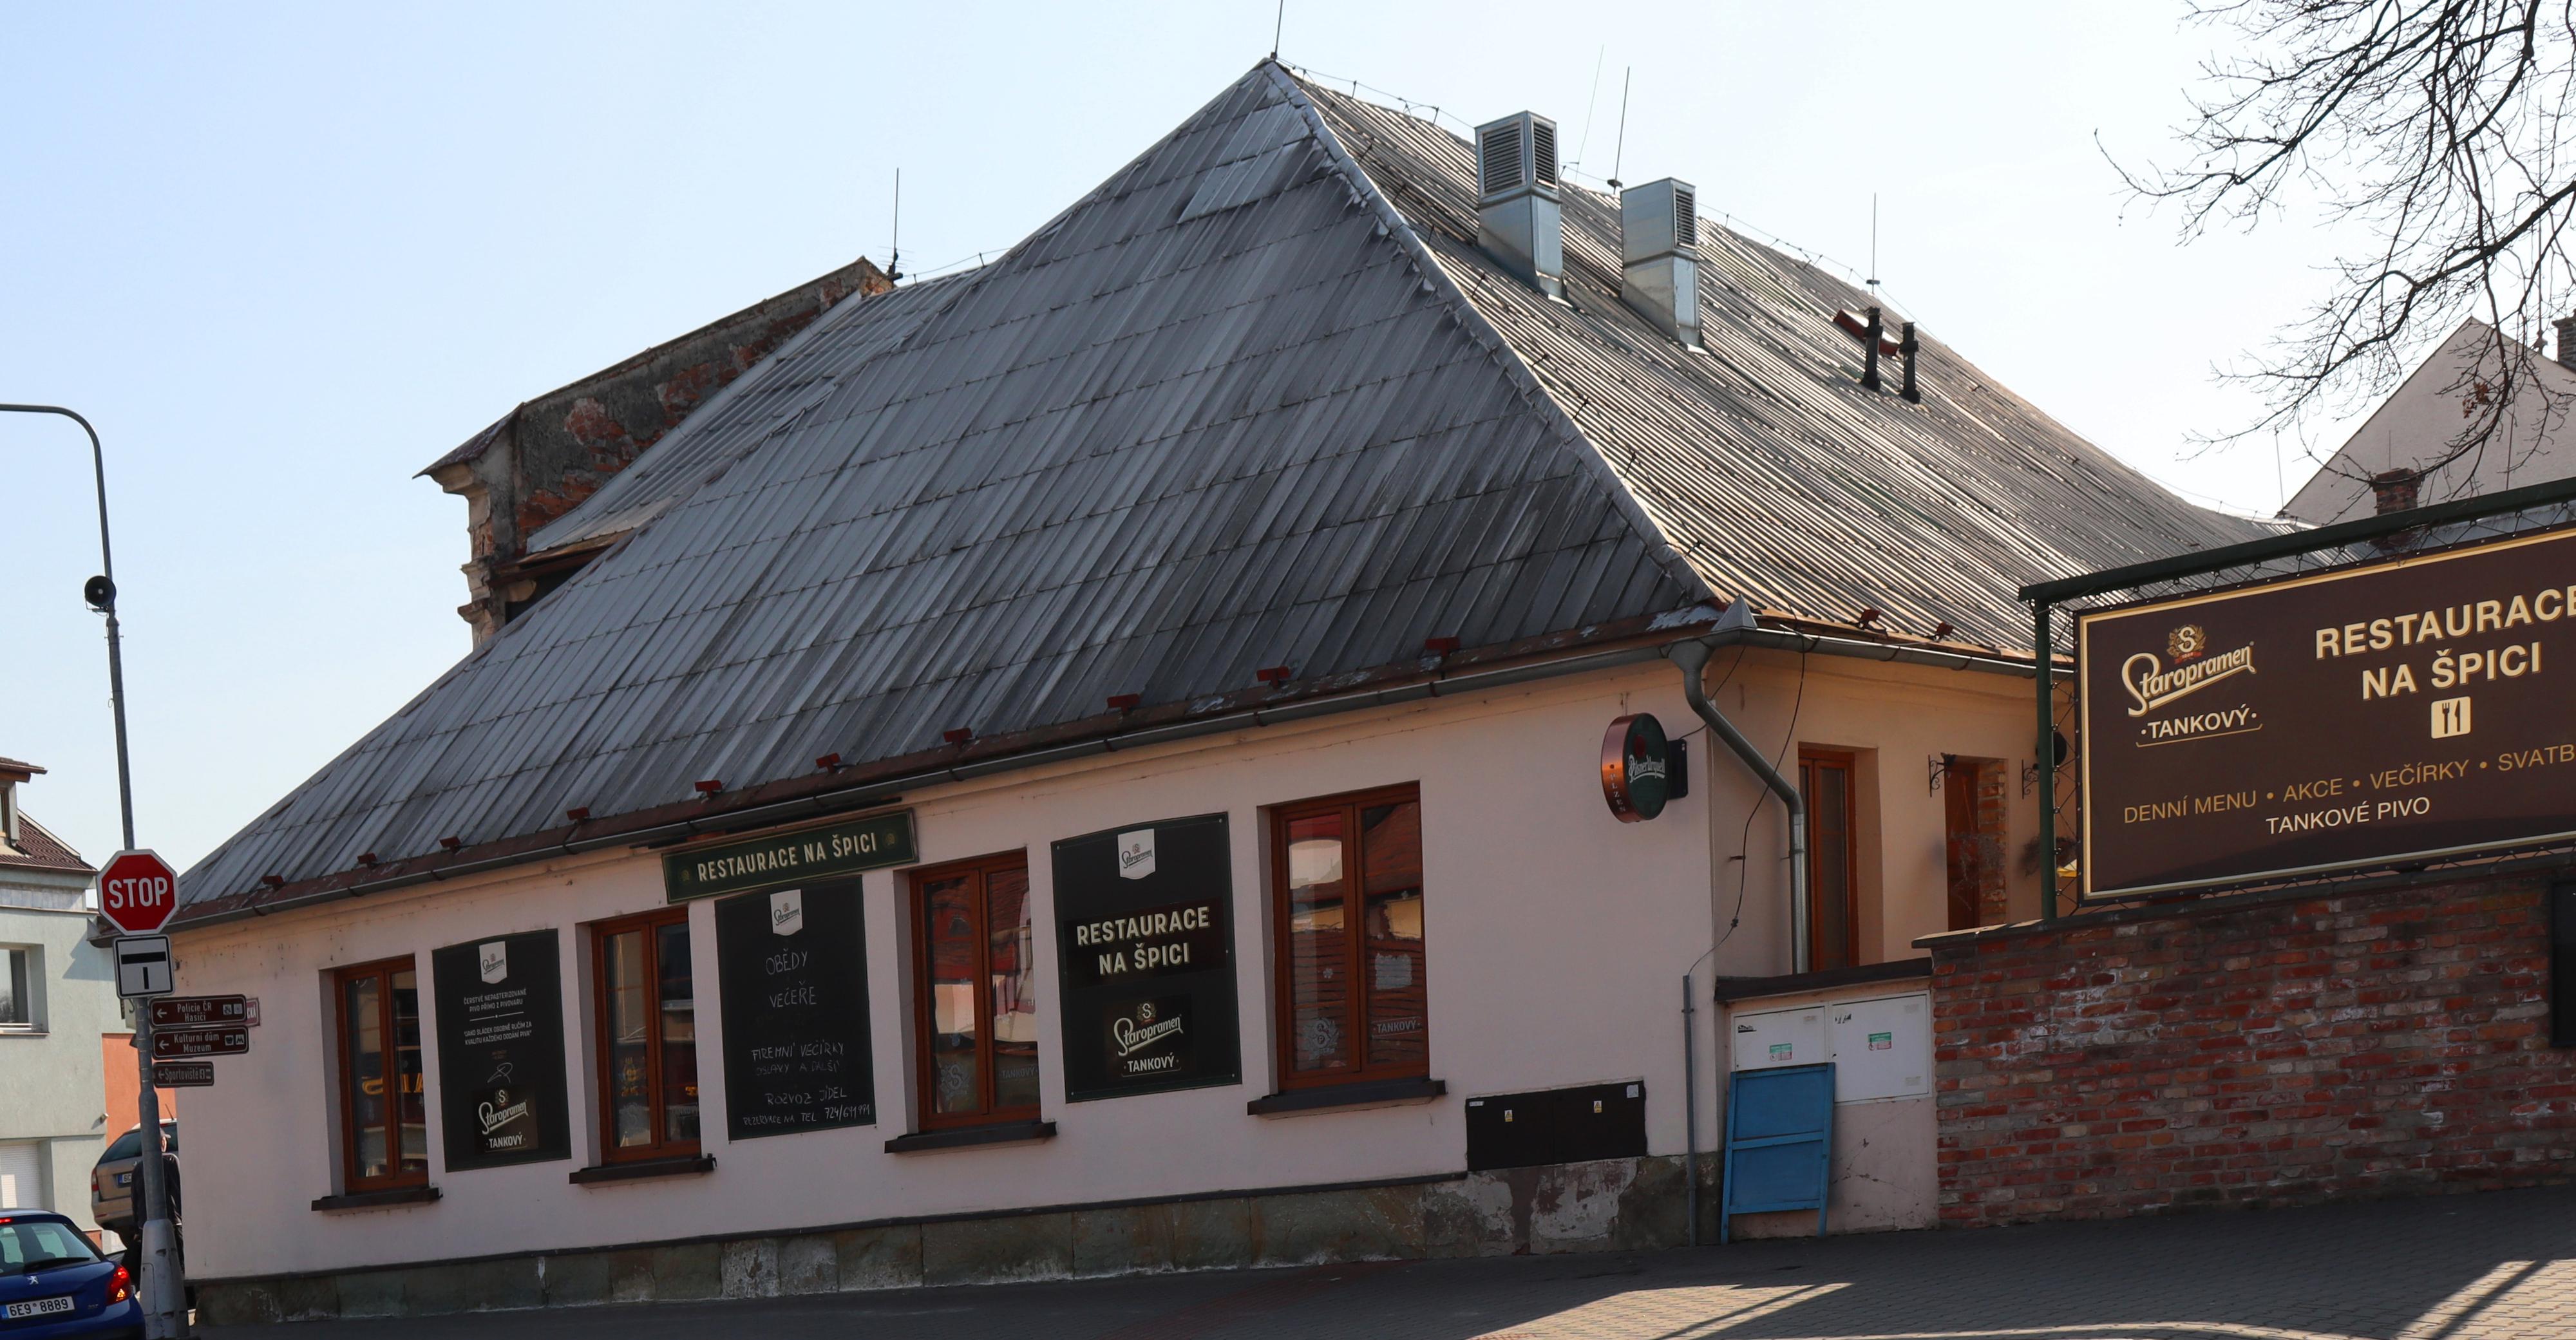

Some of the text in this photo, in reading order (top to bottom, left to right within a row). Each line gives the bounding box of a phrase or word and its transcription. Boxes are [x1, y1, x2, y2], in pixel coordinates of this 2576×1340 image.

[2121, 645, 2257, 717] Staropramen
[2362, 641, 2541, 701] NA ŠPICI
[2147, 703, 2250, 739] TANKOVÝ
[1628, 754, 1665, 783] Pilsner Urquell
[2125, 795, 2188, 824] DENNÍ
[2195, 791, 2256, 815] MENU
[2283, 778, 2343, 802] AKCE
[2370, 759, 2469, 789] VEČÍRKY
[2266, 797, 2430, 835] TANKOVÉ PIVO
[697, 833, 878, 882] RESTAURACE NA ŠPICI
[108, 876, 167, 909] STOP
[1077, 906, 1210, 946] RESTAURACE
[766, 948, 808, 975] OBĚDY
[1099, 942, 1190, 976] NA ŠPICI
[177, 1002, 212, 1013] Policie ČR
[500, 999, 523, 1008] PIVOVARU
[185, 1012, 206, 1023] Hasiči
[1377, 1017, 1416, 1033] TANKOVÝ
[174, 1032, 219, 1043] Kulturní dům
[1113, 1017, 1184, 1056] Staropramen
[184, 1044, 211, 1053] Muzeum
[752, 1042, 795, 1061] FIREMNÍ
[165, 1064, 199, 1083] Sportoviště
[1128, 1052, 1174, 1072] TANKOVÝ
[765, 1085, 848, 1105] ROZVOZ JÍDEL
[478, 1102, 529, 1135] Staropramen
[784, 1115, 795, 1124] NA
[800, 1113, 817, 1122] TEL
[489, 1132, 523, 1148] TANKOVÝ
[10, 1299, 68, 1316] 6E9 8889
